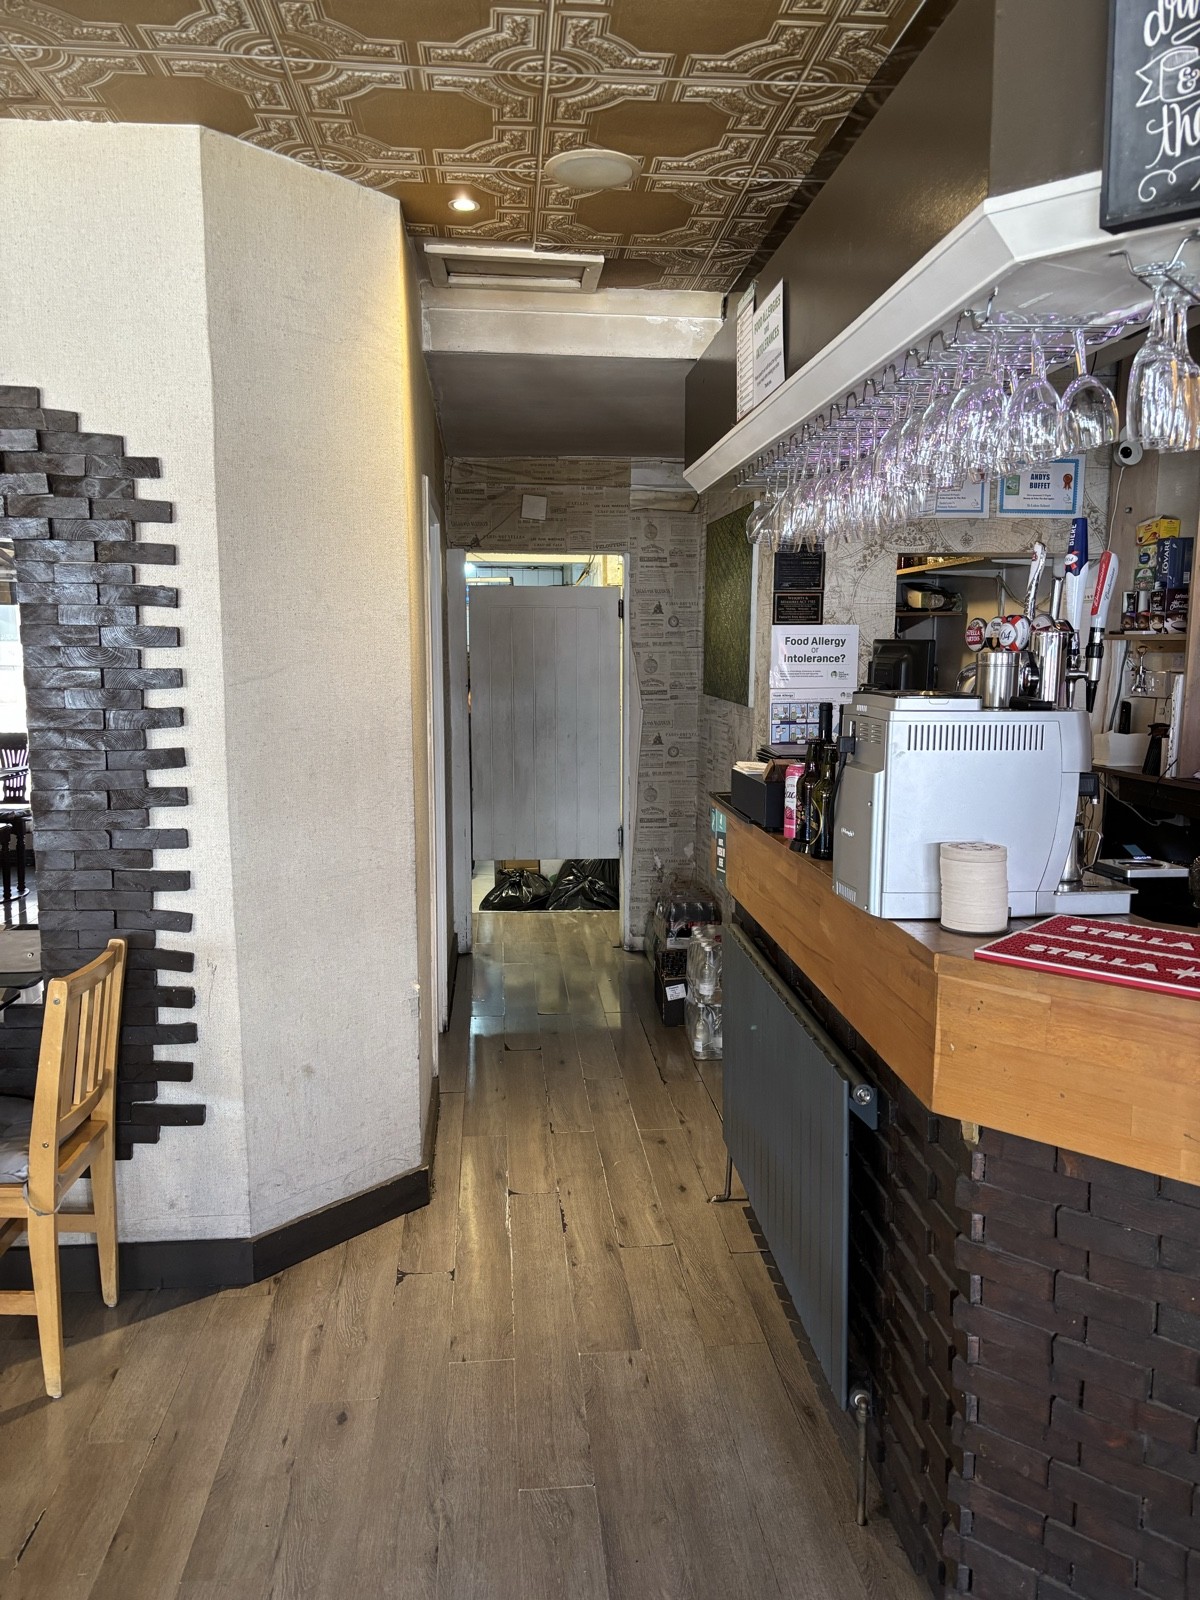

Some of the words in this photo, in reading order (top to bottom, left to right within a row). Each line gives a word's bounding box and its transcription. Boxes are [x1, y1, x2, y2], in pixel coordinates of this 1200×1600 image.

[1177, 66, 1199, 95] &
[1030, 473, 1051, 481] ANDYS
[784, 636, 809, 646] Food
[810, 636, 847, 647] Allergy
[783, 653, 846, 663] Intolerance?
[1066, 924, 1195, 950] STELLA
[1024, 943, 1158, 973] STELLA
